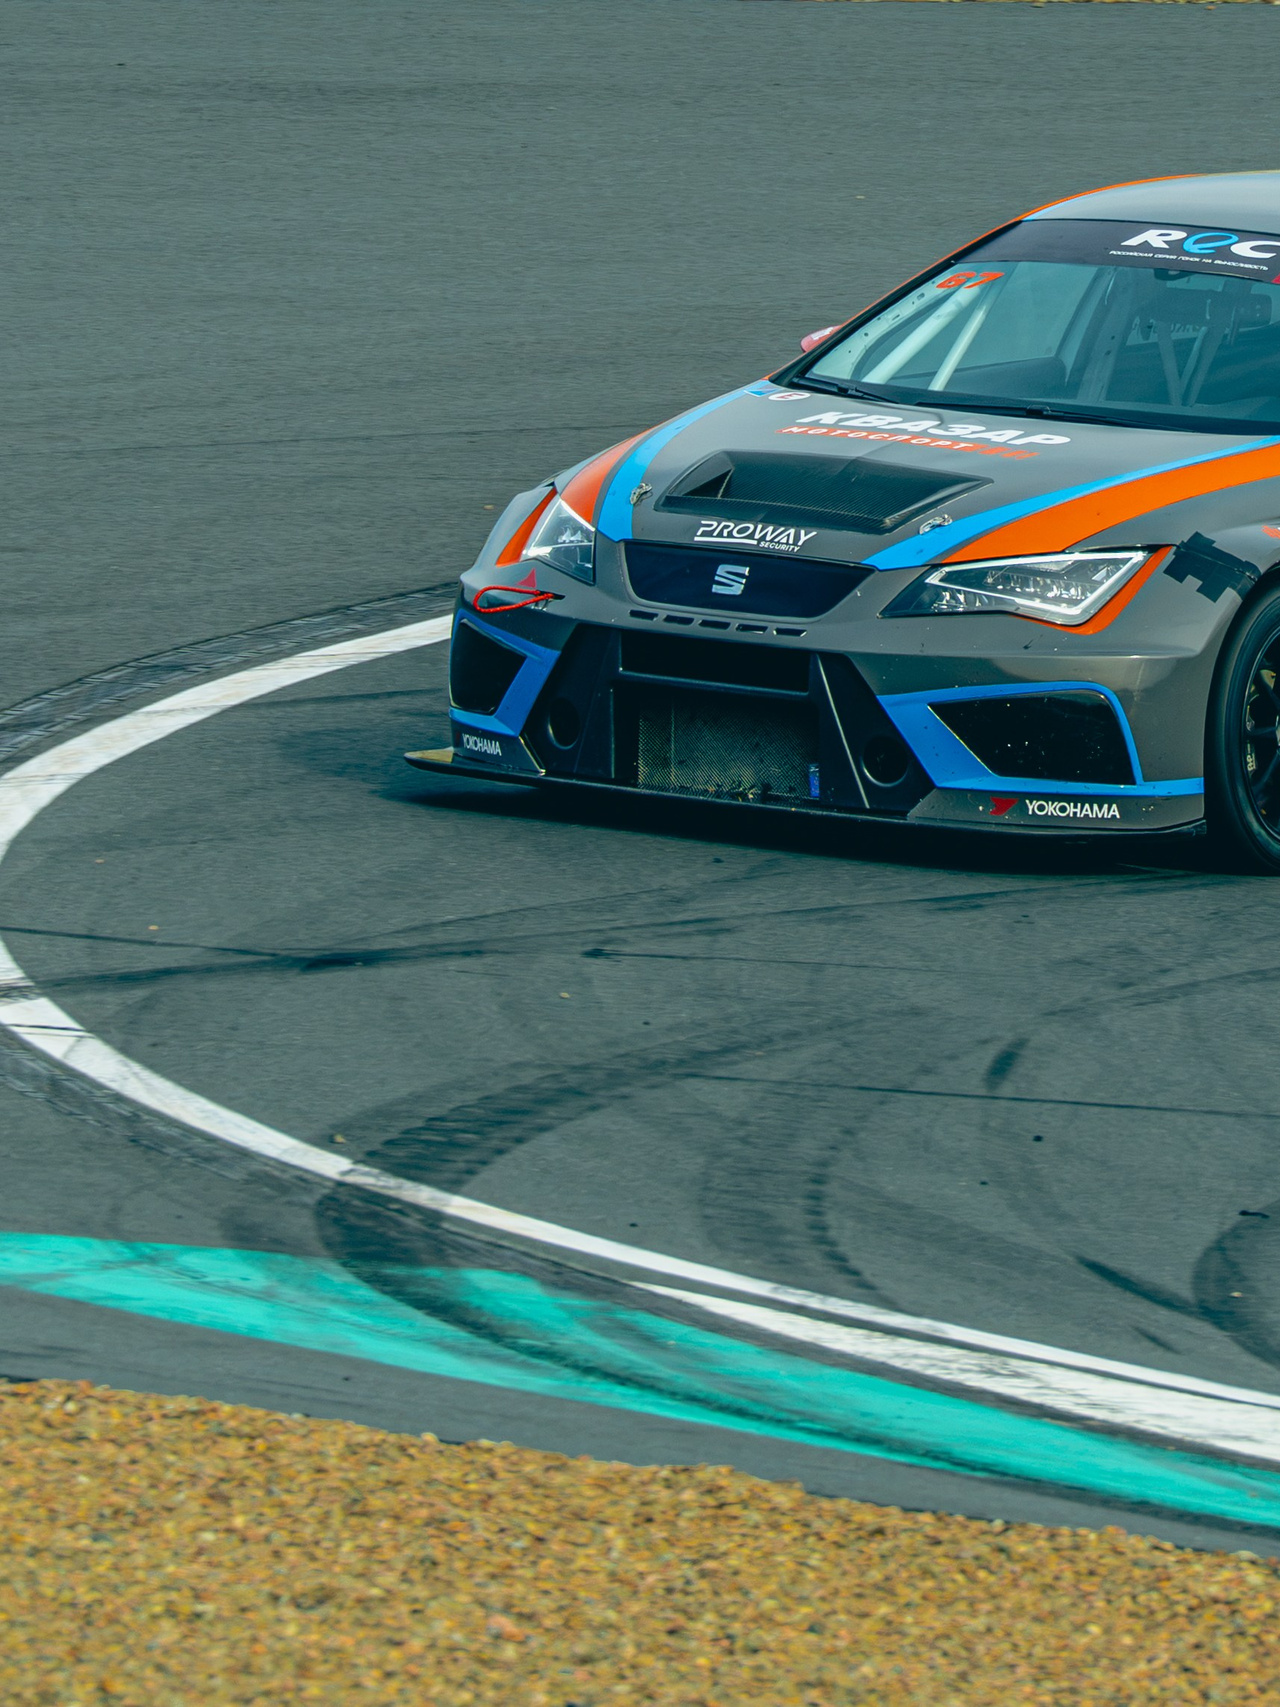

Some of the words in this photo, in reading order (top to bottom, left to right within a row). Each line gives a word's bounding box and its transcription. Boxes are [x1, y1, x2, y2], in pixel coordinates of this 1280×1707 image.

[936, 271, 1005, 289] 67
[782, 426, 974, 450] МОТОСПОРТ
[795, 411, 1071, 445] КВАЗАР
[696, 520, 818, 546] PROWAY
[759, 541, 800, 553] SECURITY
[462, 733, 502, 756] YOKOHAMA
[1025, 799, 1120, 819] YOKOHAMA
